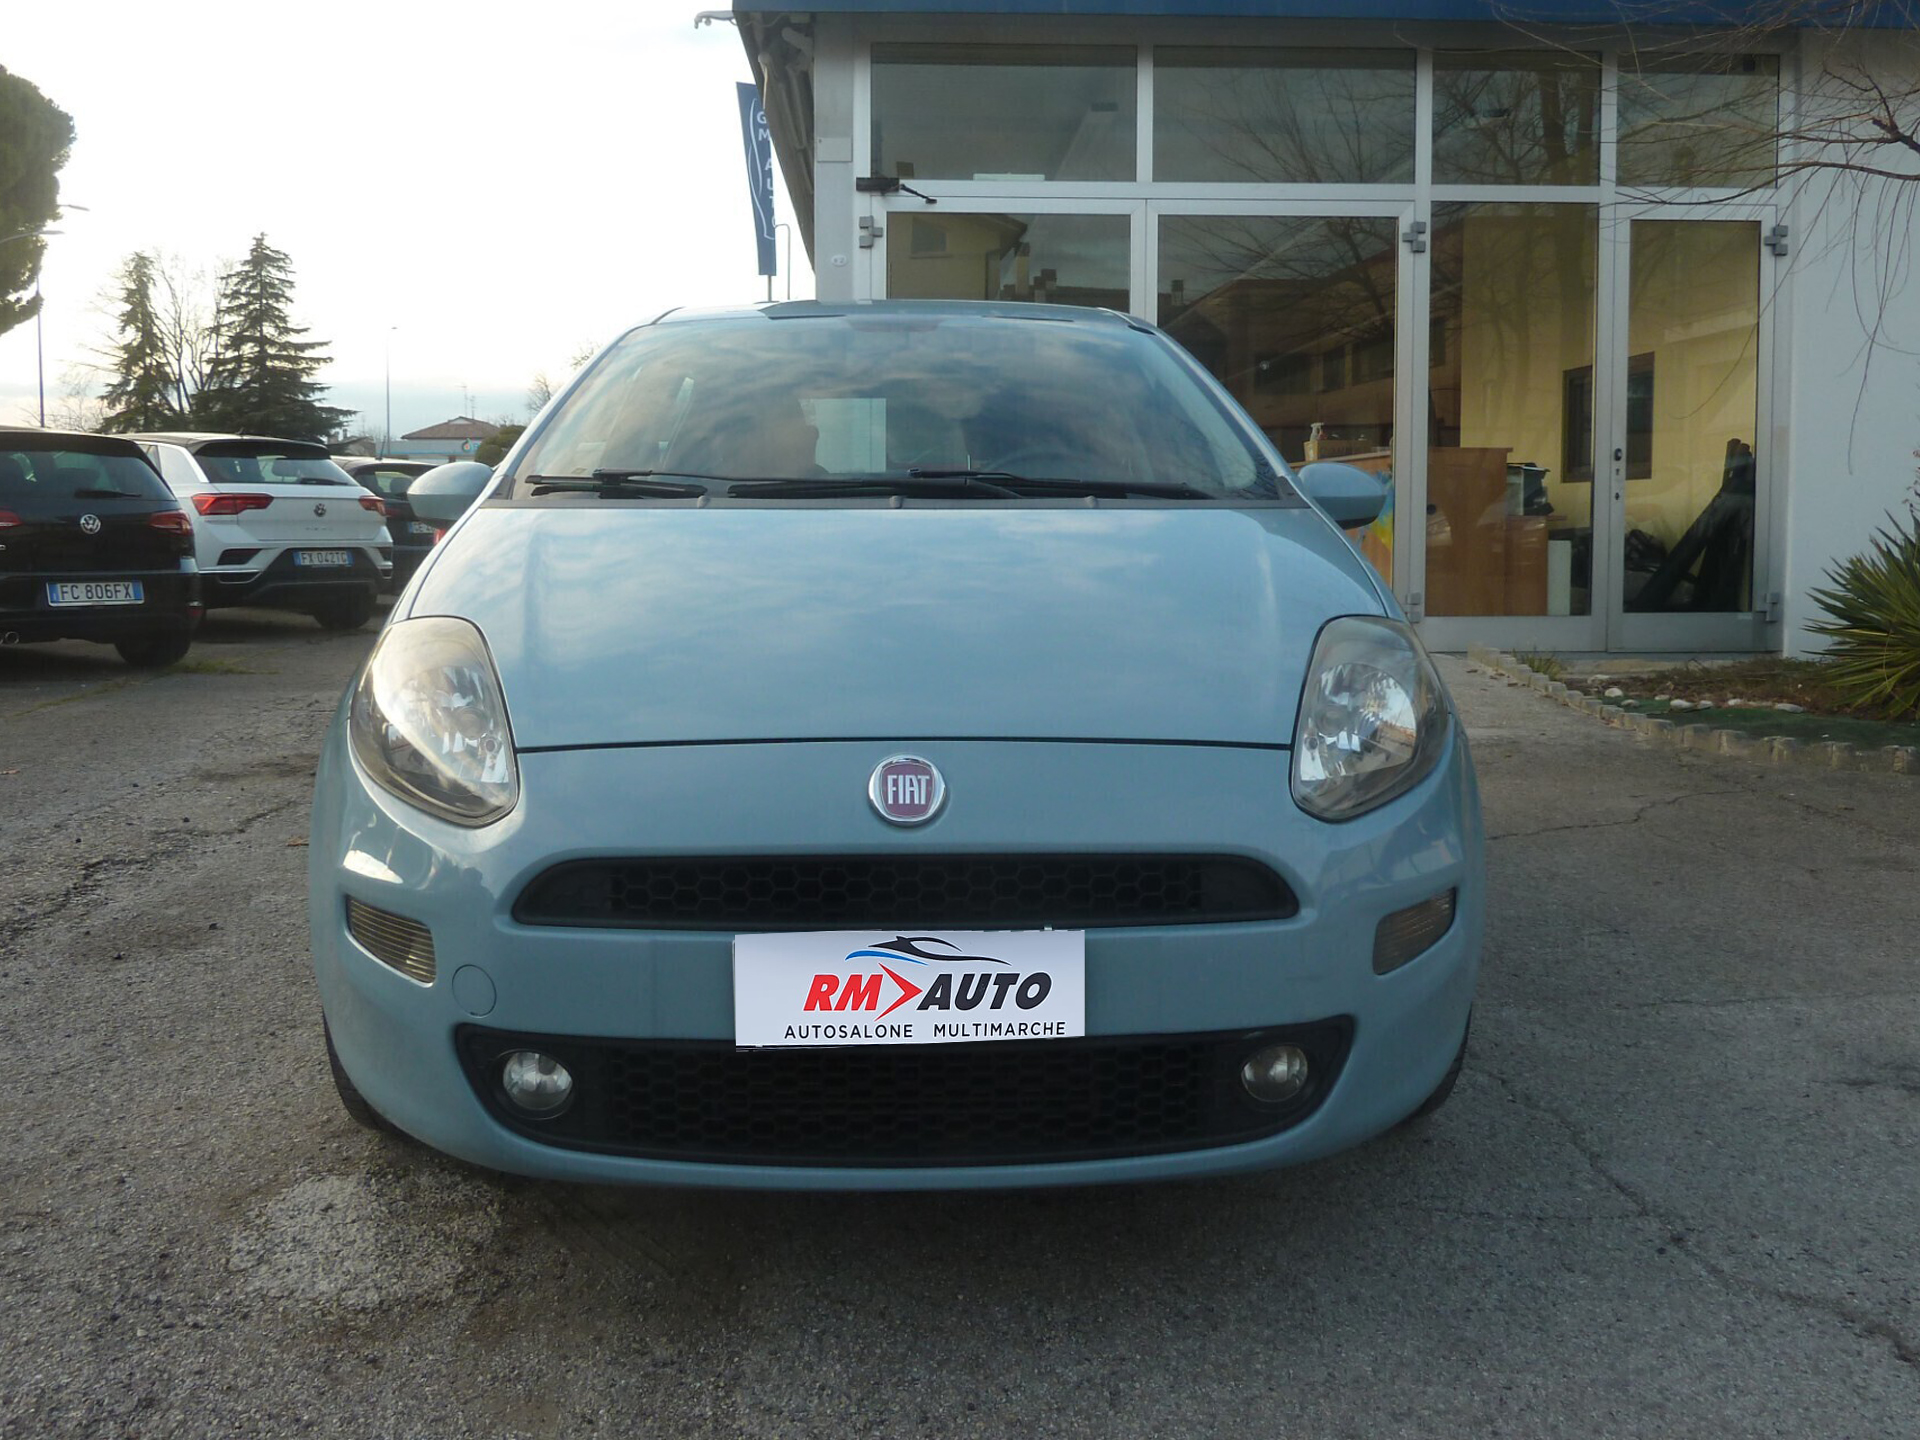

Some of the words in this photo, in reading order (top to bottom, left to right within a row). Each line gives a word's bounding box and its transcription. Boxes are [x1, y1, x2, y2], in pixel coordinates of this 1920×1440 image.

[60, 584, 80, 600] FC
[85, 583, 132, 599] 806FX
[887, 774, 930, 805] FIAT
